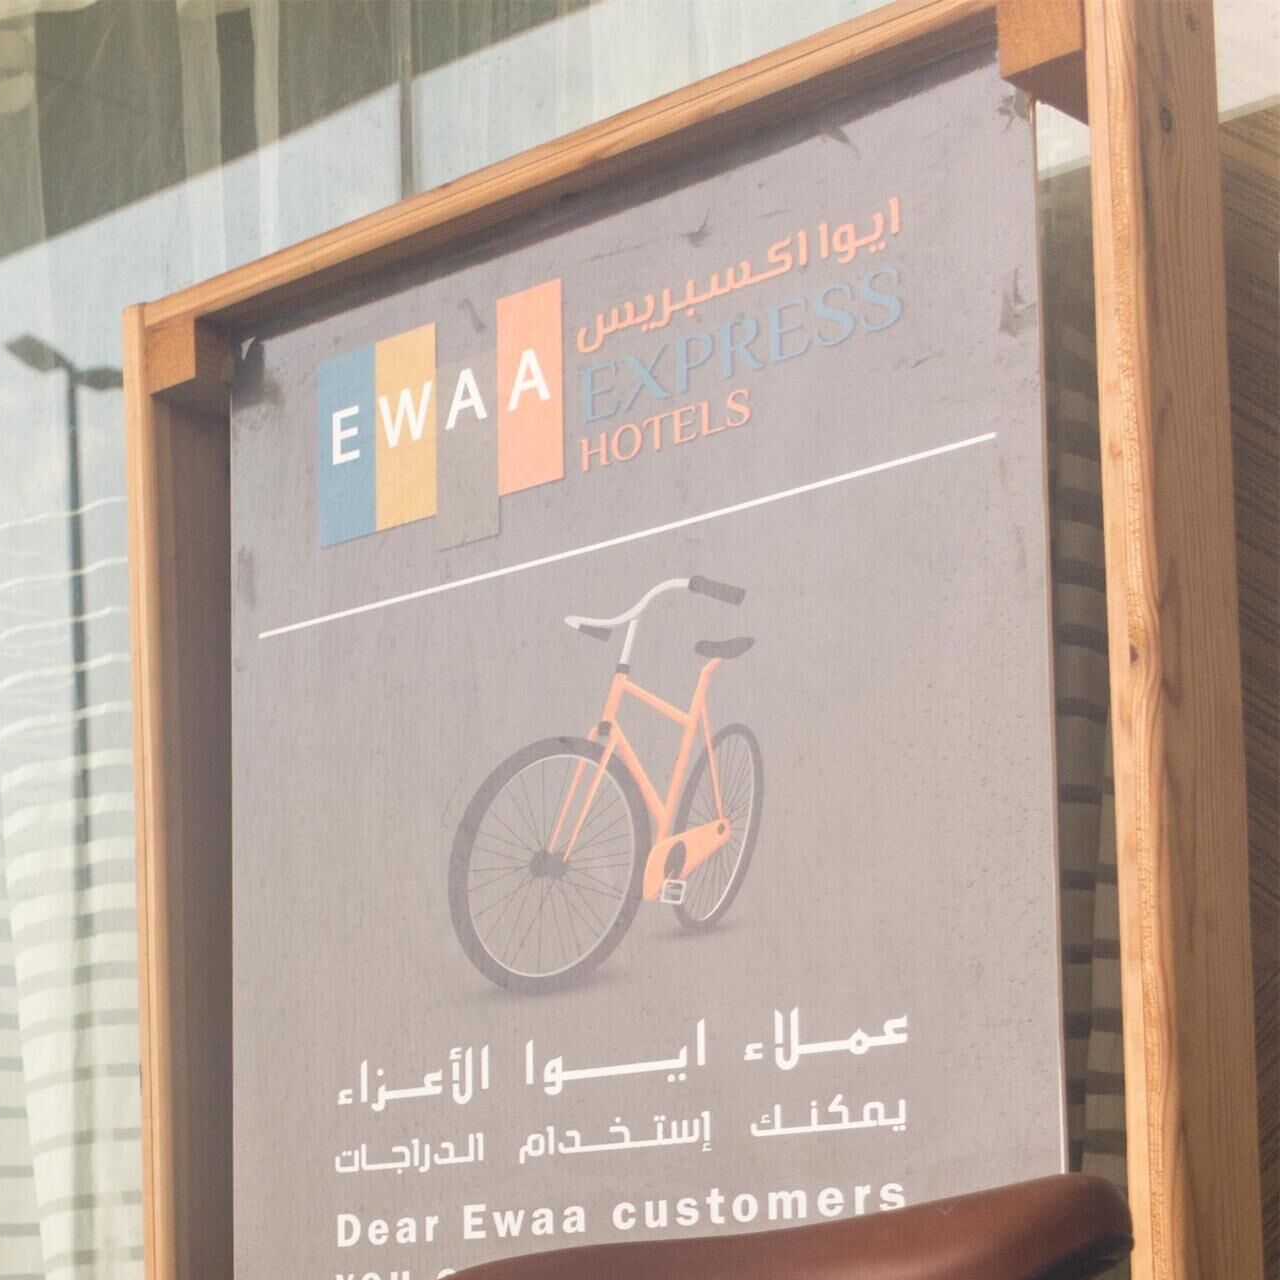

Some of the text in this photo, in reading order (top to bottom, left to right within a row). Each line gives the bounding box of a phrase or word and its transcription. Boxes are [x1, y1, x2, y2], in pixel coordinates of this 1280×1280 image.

[581, 266, 904, 424] EXPRESS
[332, 348, 550, 466] EWAA
[581, 389, 752, 473] HOTELS
[336, 1183, 907, 1248] Dear Ewaa customers
